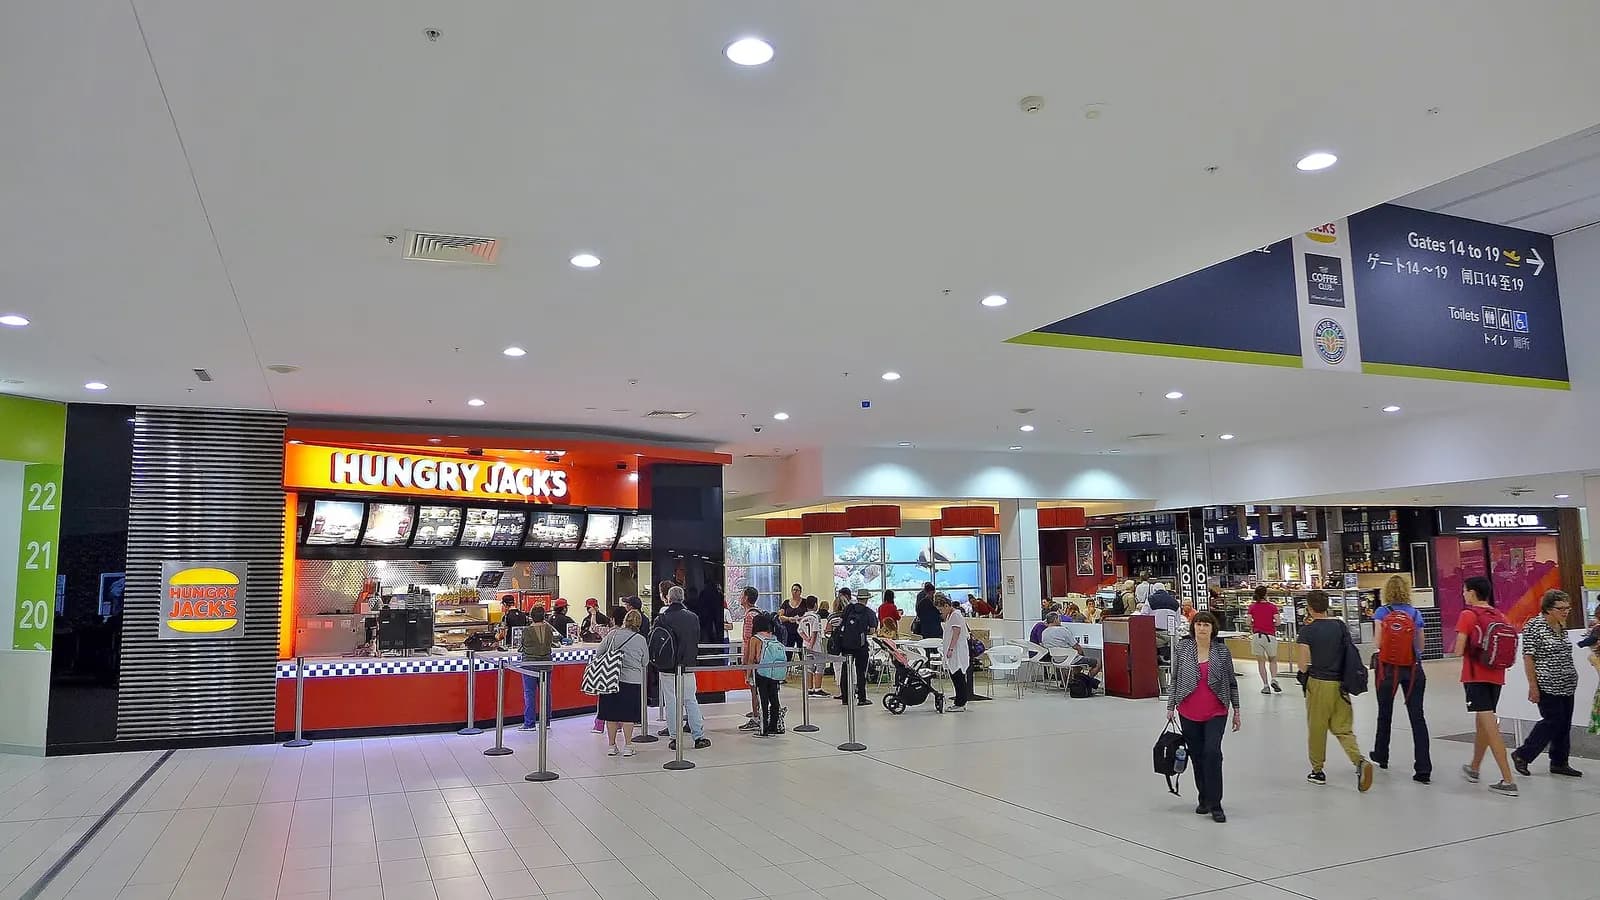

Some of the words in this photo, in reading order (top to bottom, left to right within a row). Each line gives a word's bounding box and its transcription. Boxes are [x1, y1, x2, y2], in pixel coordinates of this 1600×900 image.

[1407, 231, 1446, 253] Gates
[1449, 239, 1466, 256] 14
[1467, 244, 1482, 259] to
[1484, 246, 1500, 262] 19
[1311, 272, 1339, 285] COFFEE
[1447, 306, 1480, 322] Toilets
[1484, 333, 1508, 346] トイレ
[331, 452, 480, 492] HUNGRY
[27, 482, 56, 511] 22
[1480, 513, 1518, 527] COFFEE
[25, 541, 51, 569] 21
[1181, 543, 1189, 562] THE
[1195, 542, 1204, 561] THE
[168, 586, 238, 599] HUNGRY
[1196, 563, 1208, 611] COFFEE
[20, 600, 48, 629] 20
[168, 600, 238, 619] JACK'S
